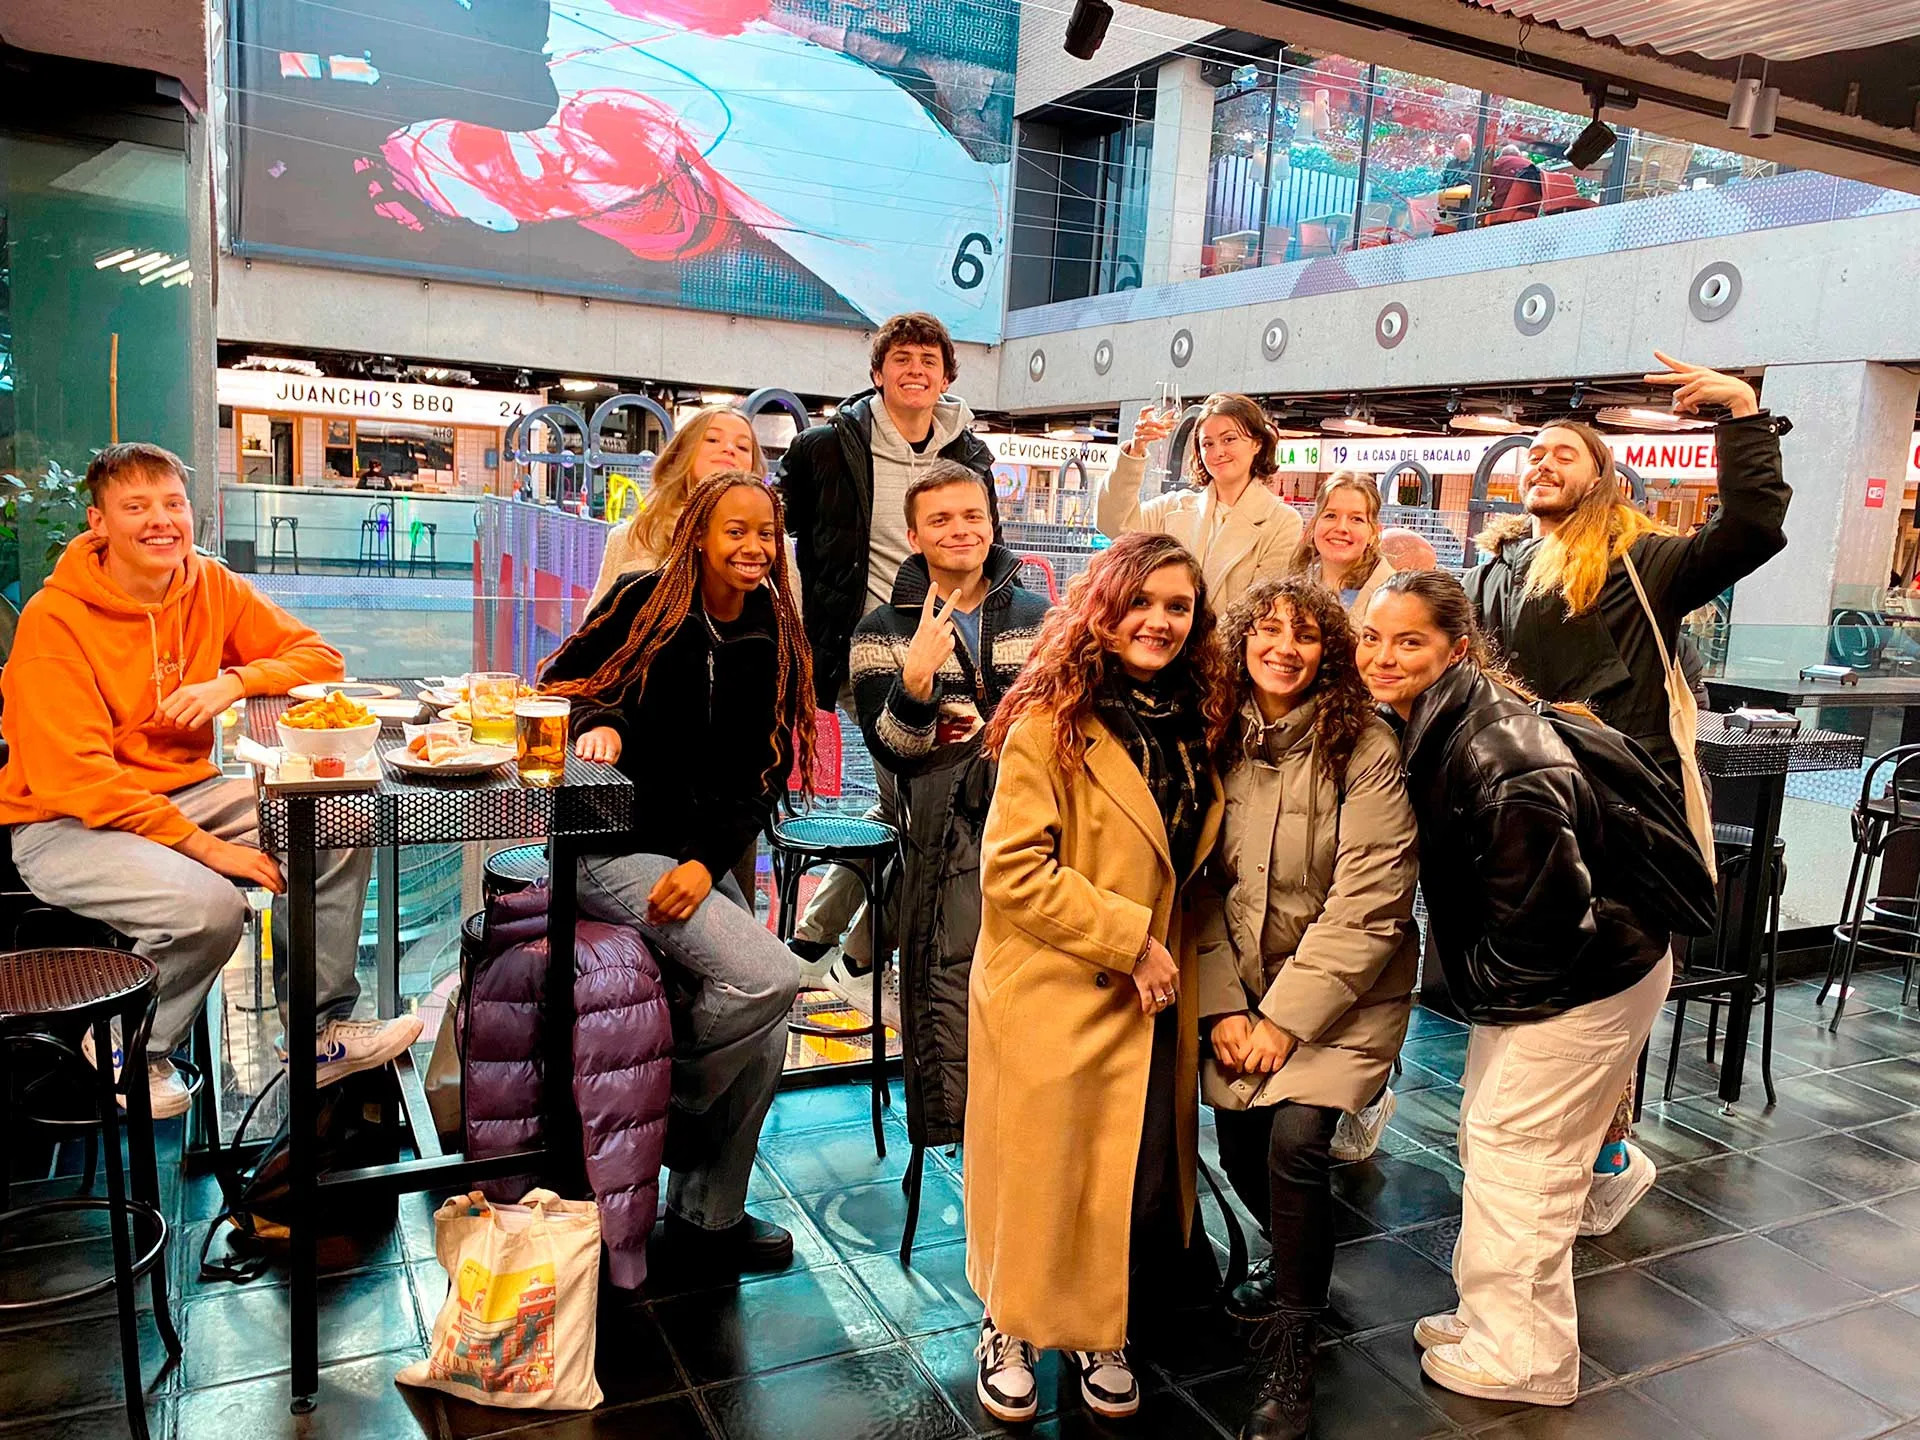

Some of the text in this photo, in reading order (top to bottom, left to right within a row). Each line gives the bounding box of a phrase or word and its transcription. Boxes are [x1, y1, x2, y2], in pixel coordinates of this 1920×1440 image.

[952, 232, 992, 290] 6
[276, 383, 453, 413] JUANCHO'S BBQ
[500, 401, 523, 417] 24
[1305, 447, 1318, 464] 18
[1333, 446, 1471, 464] 19 LA CASA DEL BACALAO
